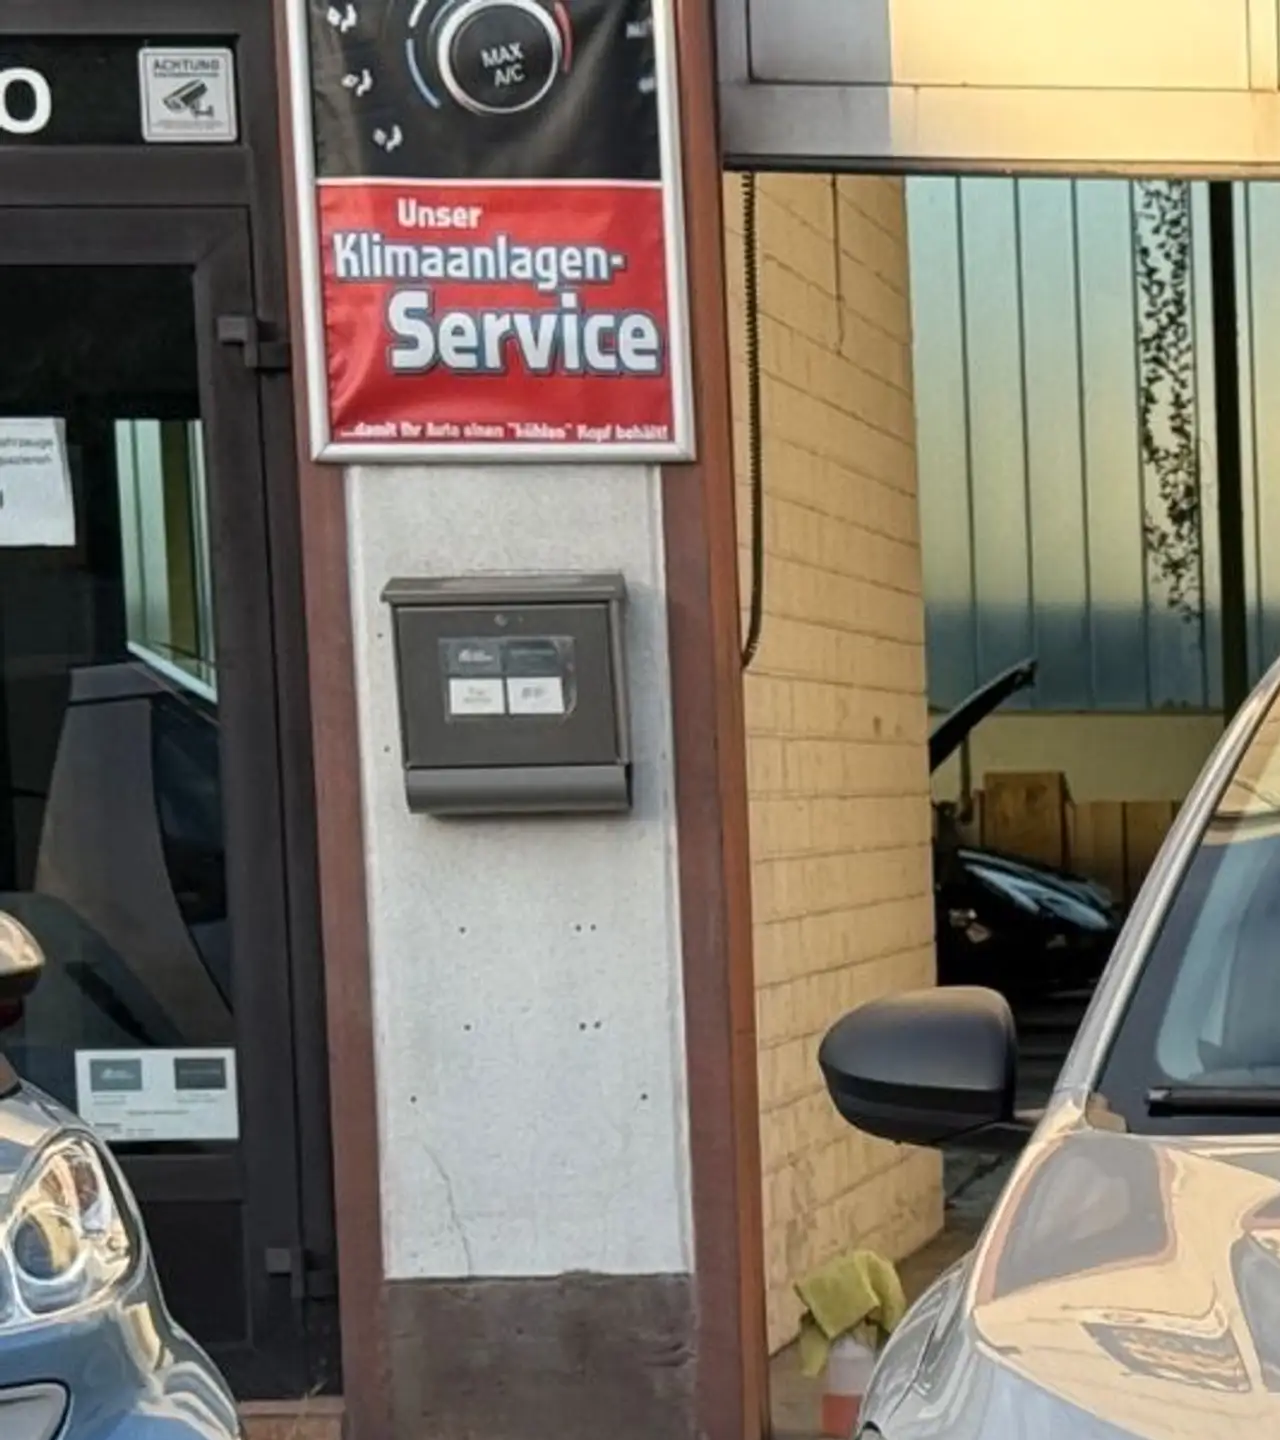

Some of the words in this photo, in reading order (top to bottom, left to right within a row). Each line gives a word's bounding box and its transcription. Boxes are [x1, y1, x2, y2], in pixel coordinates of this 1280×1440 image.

[153, 58, 220, 71] ACHTUNG
[480, 42, 526, 69] MAX
[494, 63, 526, 88] A/C
[397, 198, 483, 228] Unser
[332, 232, 625, 291] Klimaanlagen-
[387, 289, 660, 371] Service
